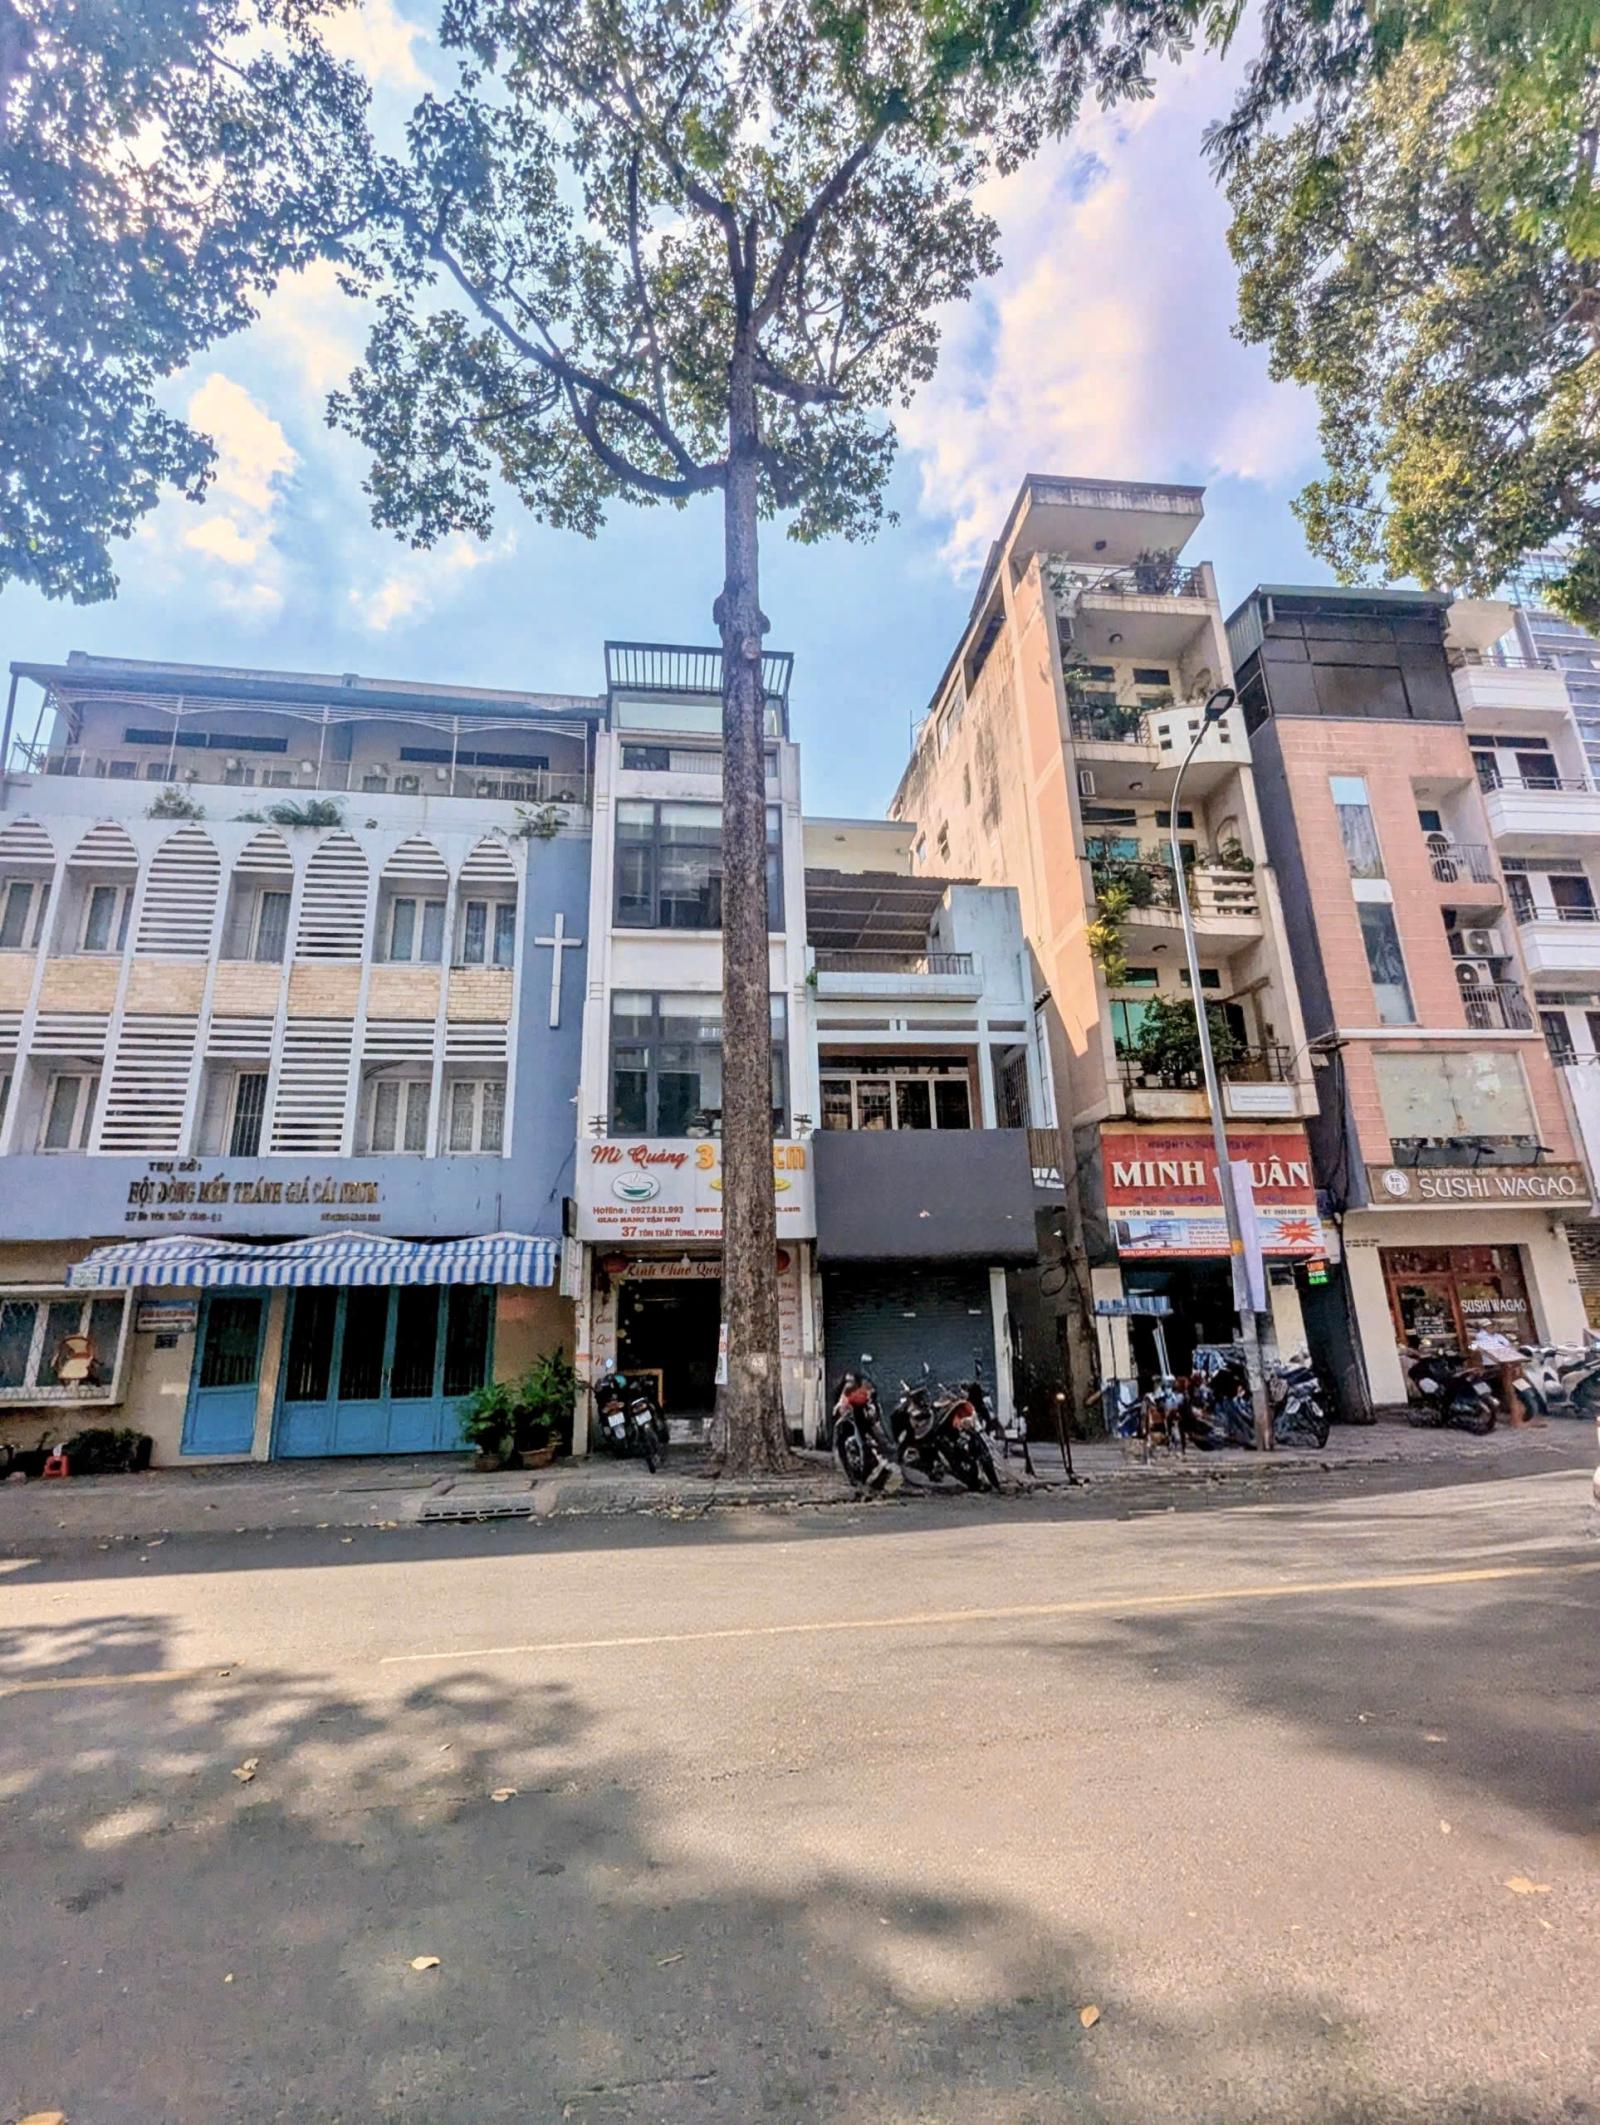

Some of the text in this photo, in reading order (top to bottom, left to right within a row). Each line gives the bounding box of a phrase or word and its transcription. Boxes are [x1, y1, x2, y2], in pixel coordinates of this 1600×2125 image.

[1111, 1154, 1310, 1188] MINH UÂN
[1419, 1178, 1490, 1198] SUSHI
[1494, 1175, 1576, 1196] WAGAO
[621, 1226, 638, 1237] 37
[1461, 1300, 1491, 1312] SUSHI
